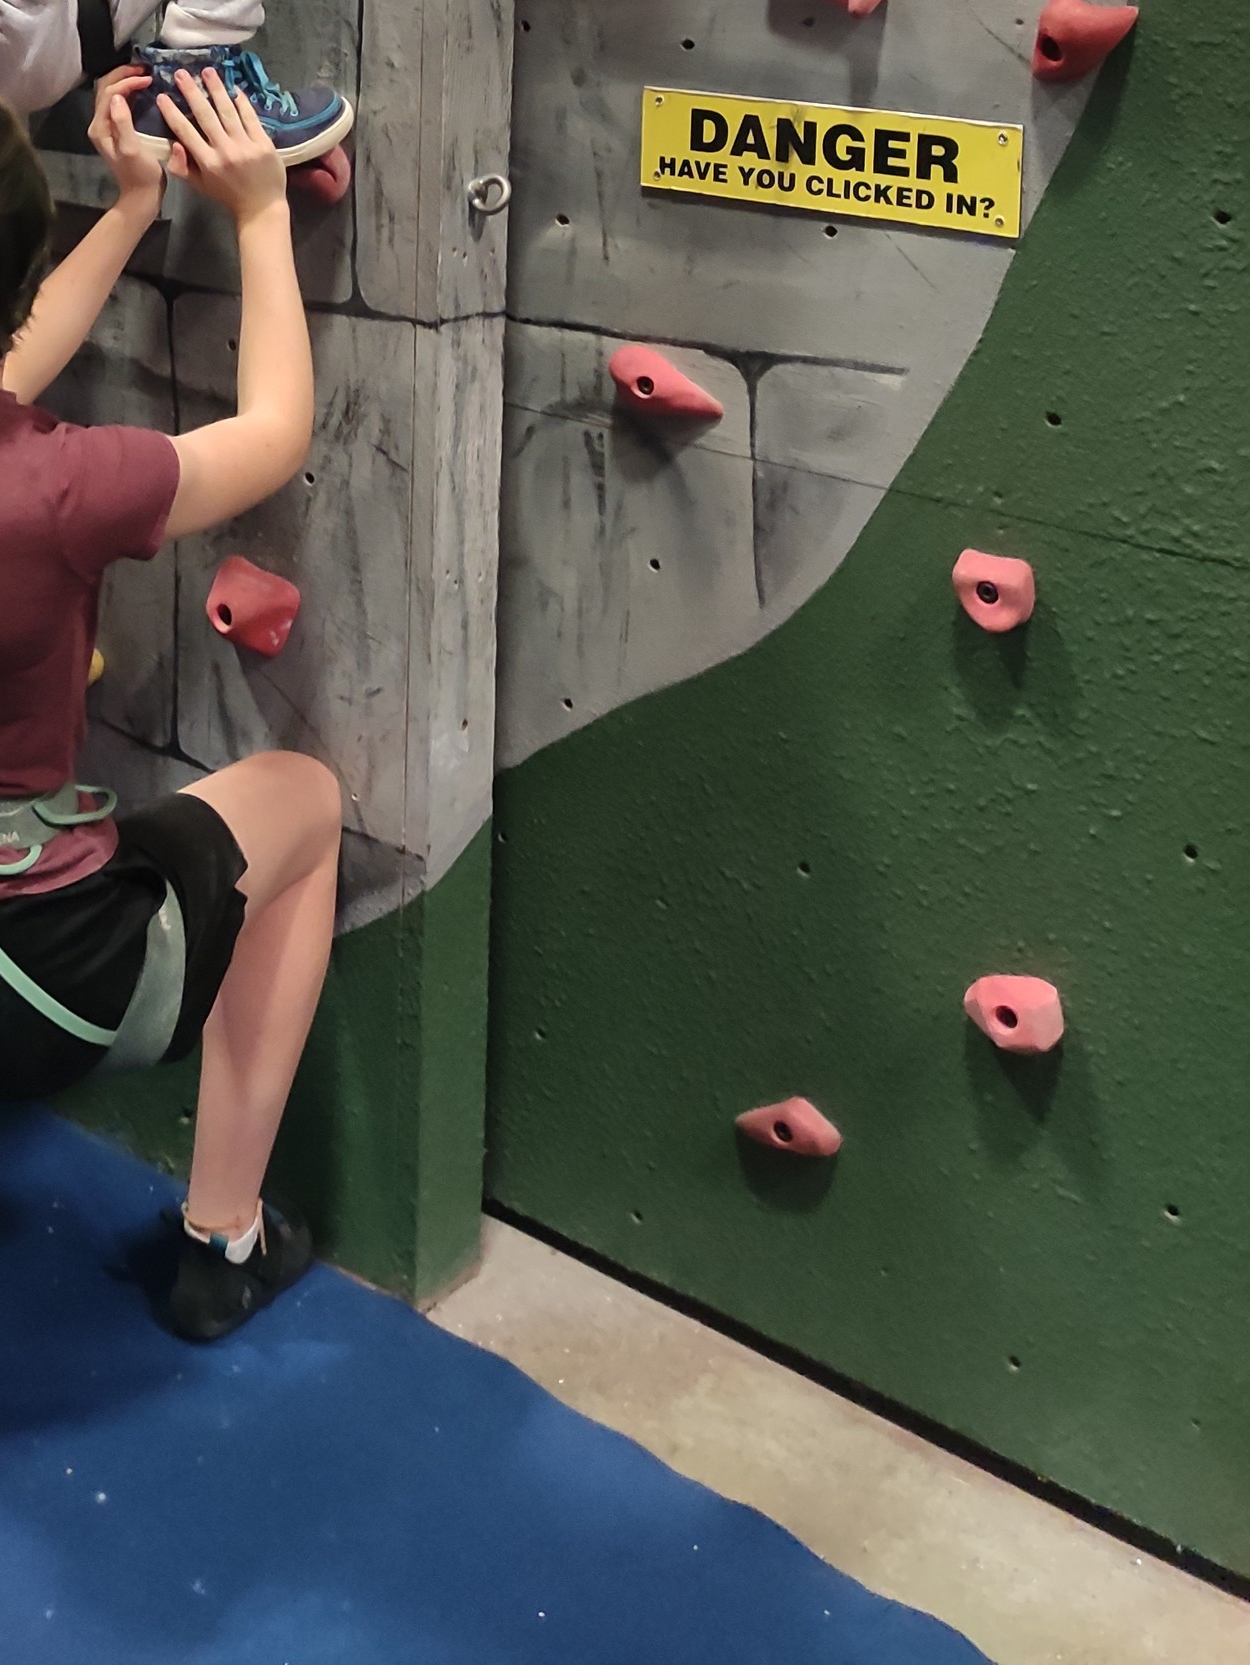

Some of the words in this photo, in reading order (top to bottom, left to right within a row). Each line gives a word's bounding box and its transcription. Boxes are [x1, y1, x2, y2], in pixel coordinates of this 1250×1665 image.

[689, 107, 960, 184] DANGER
[658, 156, 728, 184] HAVE
[737, 168, 796, 192] YOU
[805, 175, 935, 210] CLICKED
[945, 192, 995, 219] IN?
